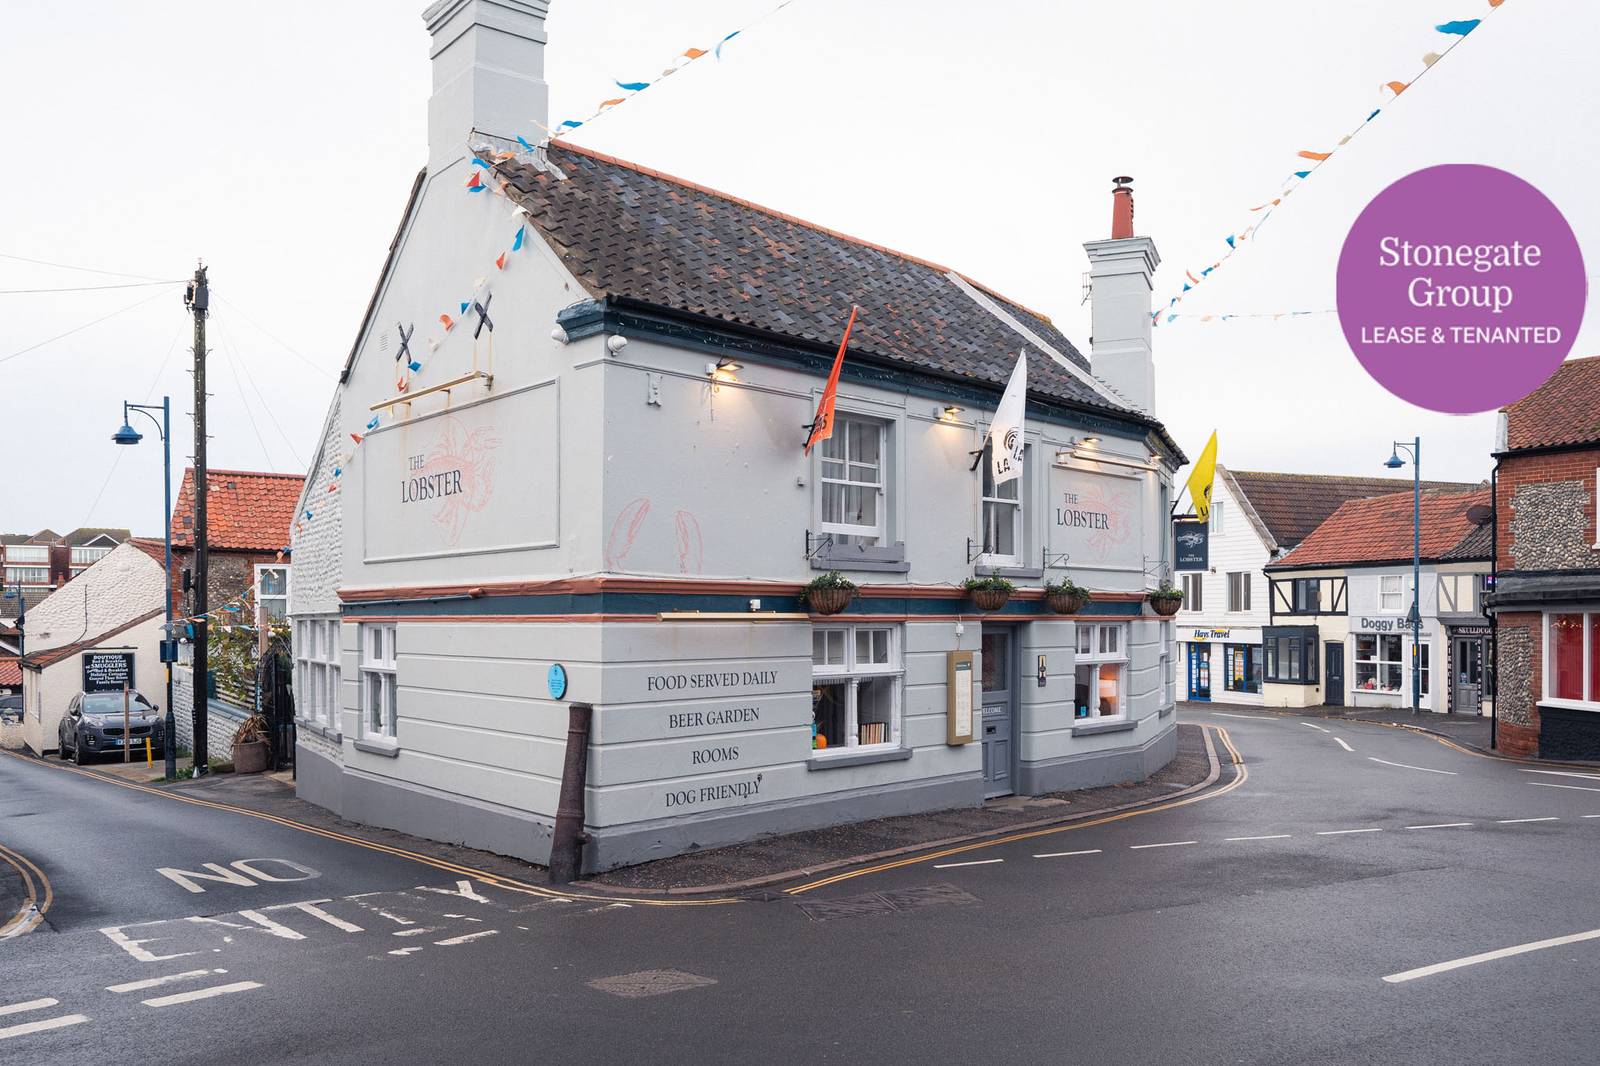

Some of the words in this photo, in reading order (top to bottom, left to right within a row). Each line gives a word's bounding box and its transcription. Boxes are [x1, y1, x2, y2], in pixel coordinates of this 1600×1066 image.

[408, 454, 425, 471] THE
[401, 469, 462, 503] LOBSTER
[1064, 492, 1079, 505] THE
[1056, 507, 1109, 530] LOBSTER
[1194, 629, 1210, 639] Hays
[1210, 629, 1231, 639] Travel
[1361, 618, 1394, 631] Doggy
[648, 674, 687, 691] FOOD
[690, 672, 740, 689] SERVED
[743, 670, 778, 686] DAILY
[669, 712, 704, 729] BEER
[706, 707, 760, 725] GARDEN
[692, 746, 739, 765] ROOMS
[665, 789, 696, 807] DOG
[700, 774, 762, 802] FRIENDLY
[155, 857, 322, 894] NO
